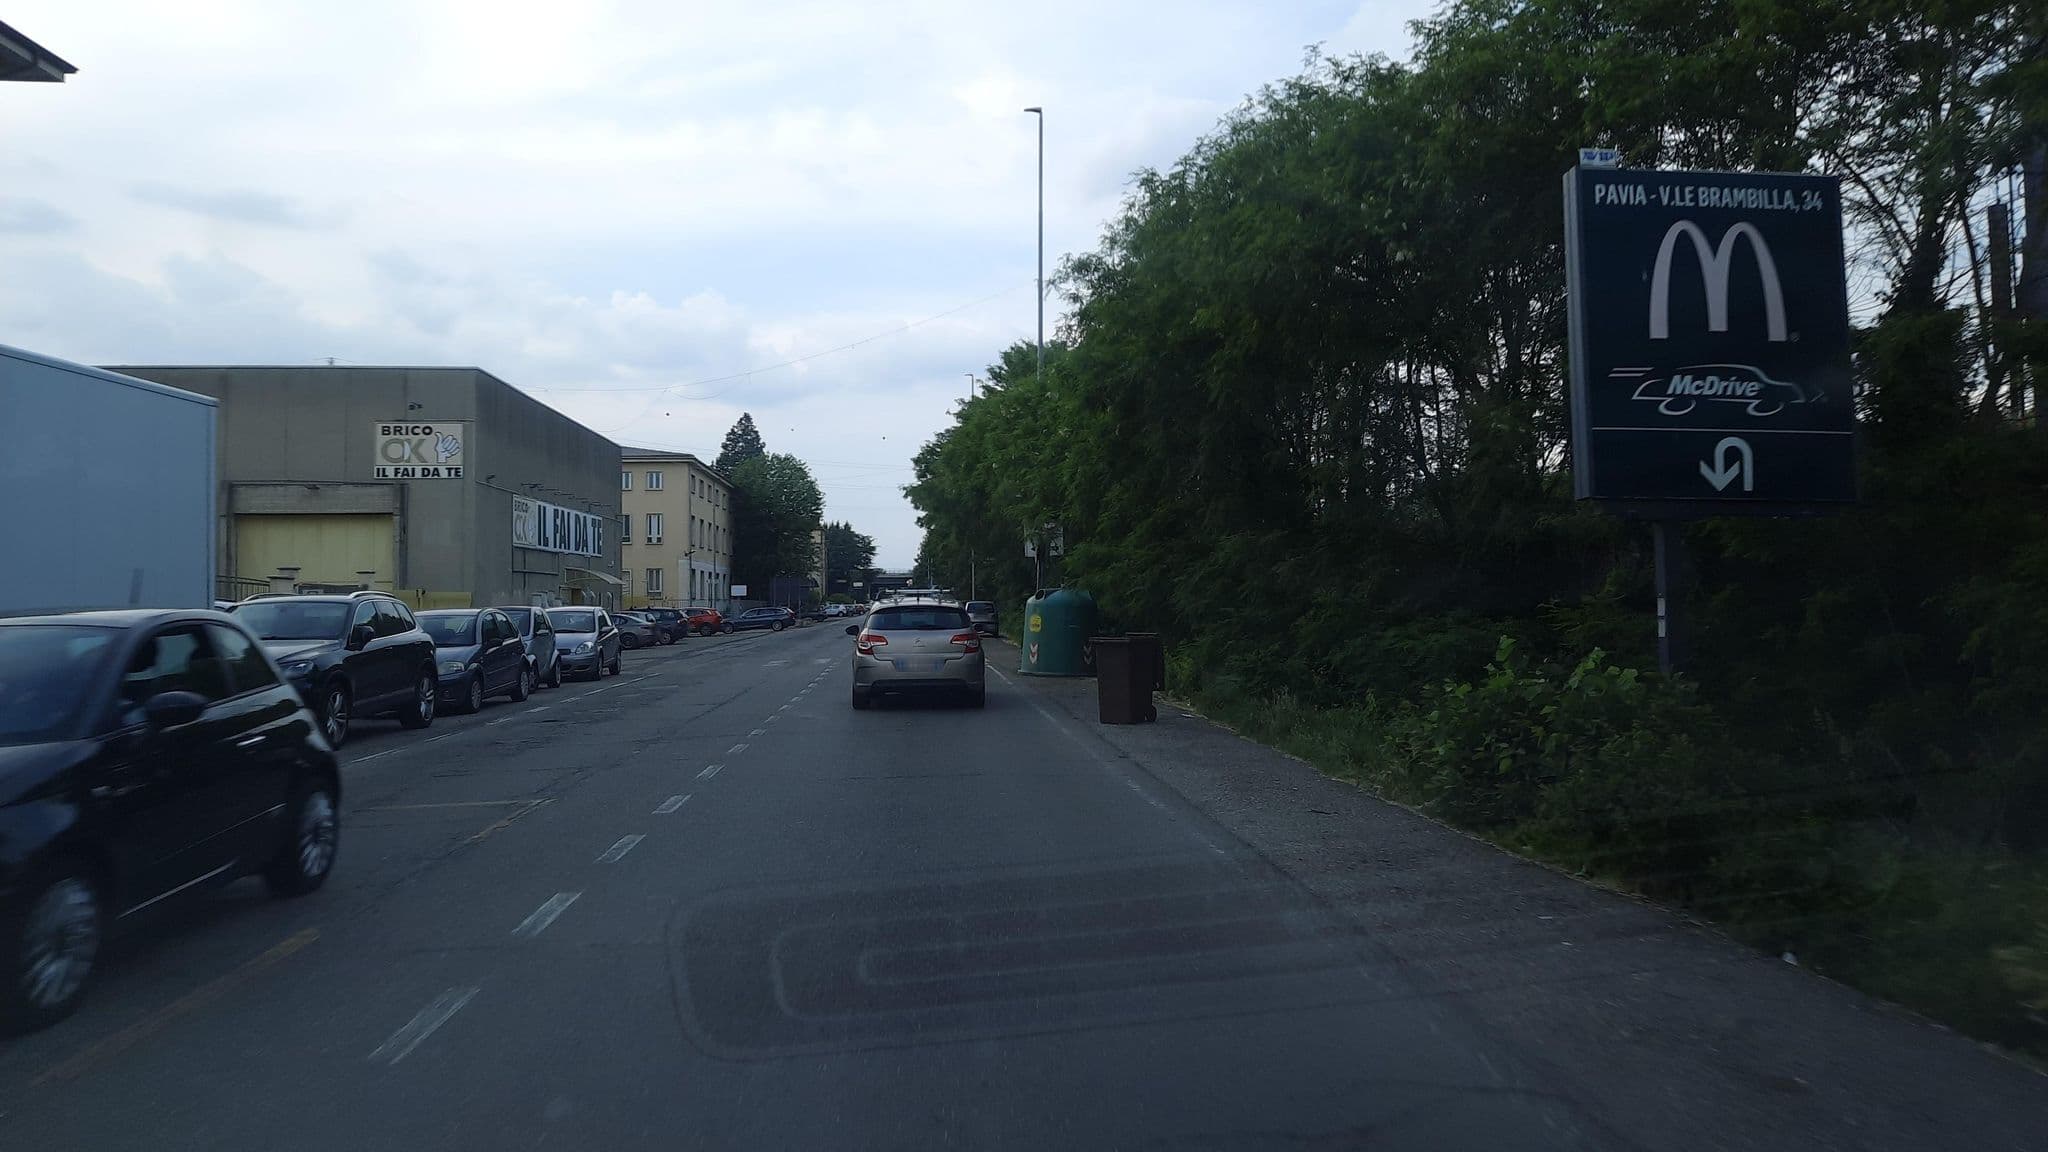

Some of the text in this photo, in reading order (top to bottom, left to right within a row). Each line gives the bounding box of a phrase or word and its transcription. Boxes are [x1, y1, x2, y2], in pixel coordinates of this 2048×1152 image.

[1594, 183, 1647, 205] PAVIA
[1658, 185, 1696, 207] V.LE
[1698, 186, 1800, 213] BRAMBILLA,
[1801, 189, 1823, 211] 34
[1666, 374, 1762, 397] McDrive
[381, 425, 433, 436] BRICO
[381, 438, 428, 464] OK
[375, 467, 462, 478] IL FAI DA TE
[537, 504, 602, 555] IL FAI DA TE
